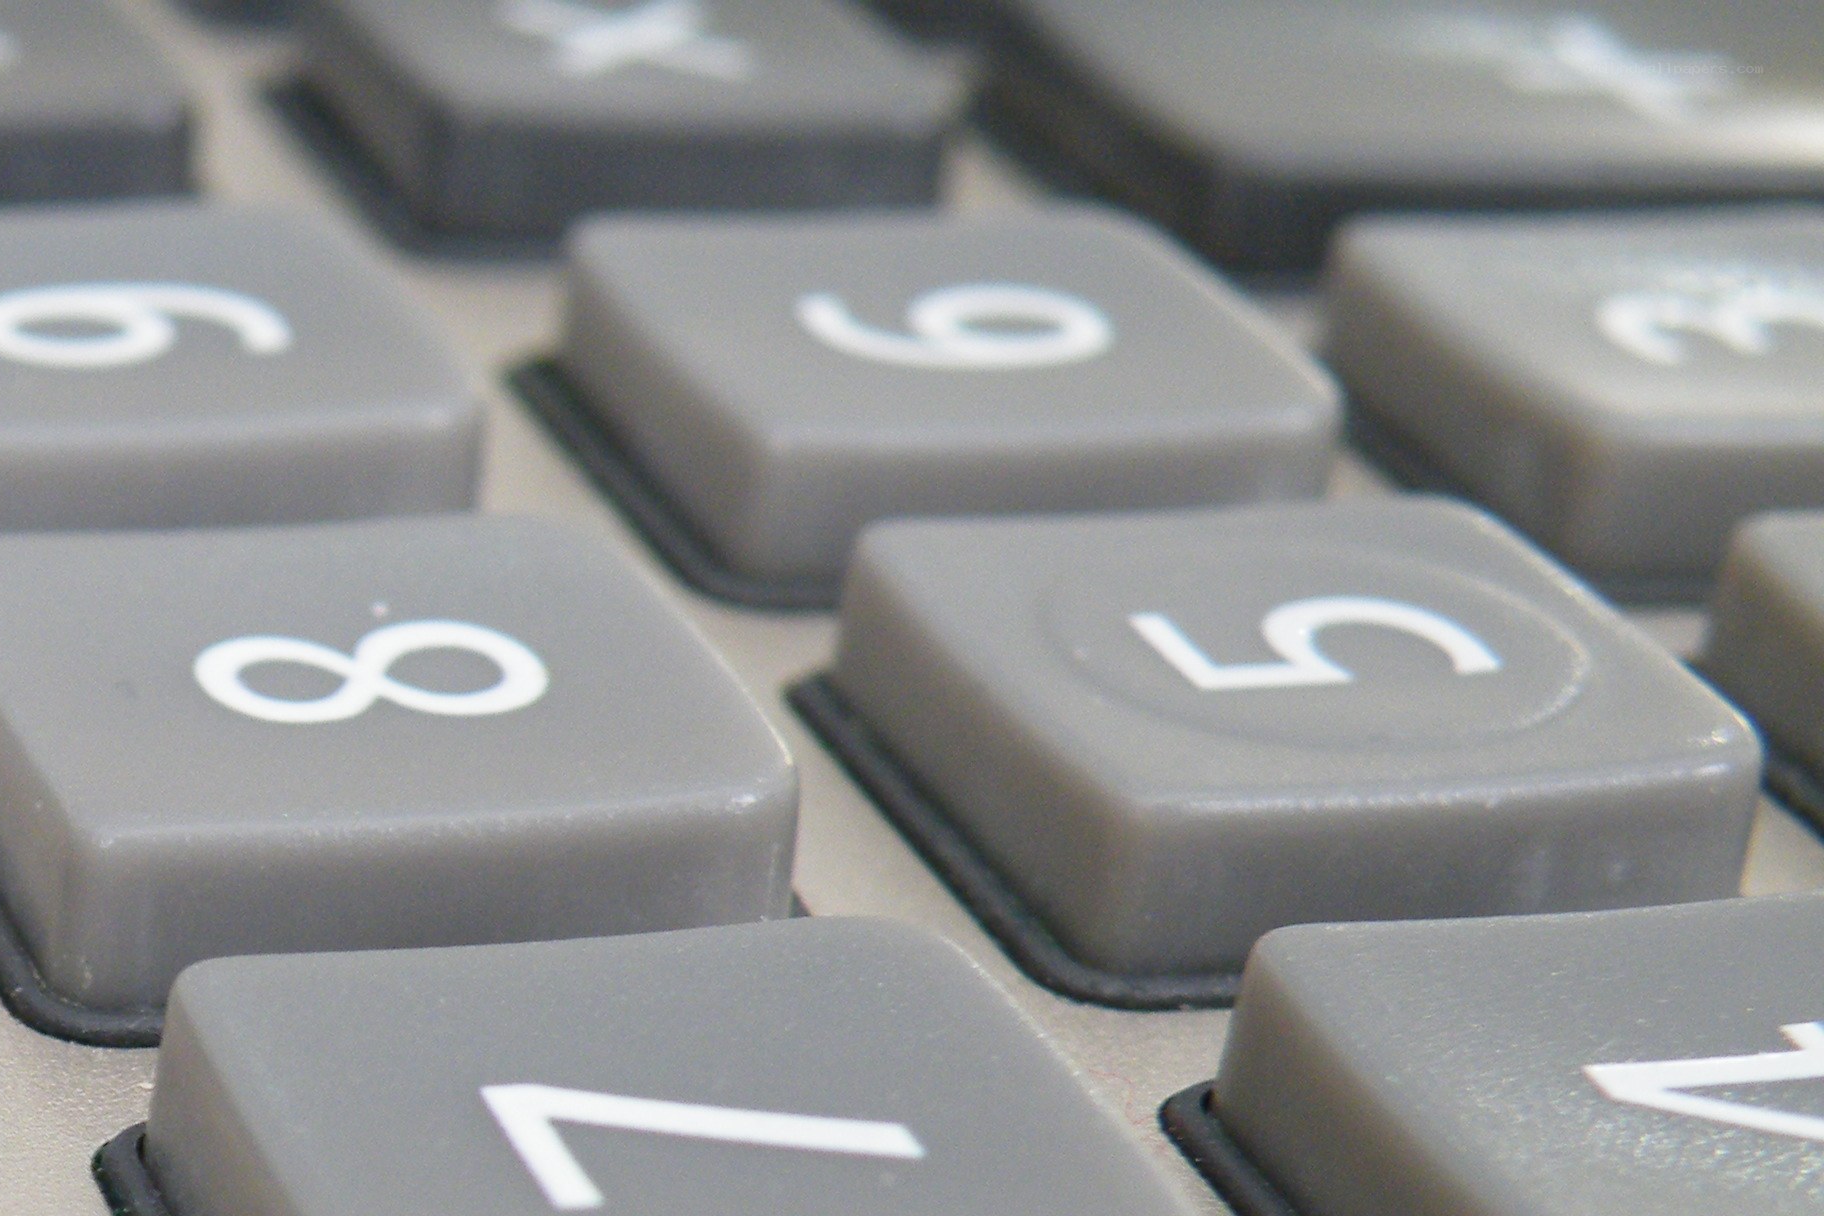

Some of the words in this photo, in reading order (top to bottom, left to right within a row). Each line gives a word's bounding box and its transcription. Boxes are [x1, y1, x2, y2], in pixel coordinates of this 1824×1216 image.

[796, 282, 1113, 369] 6
[193, 619, 548, 723] 8
[1127, 596, 1504, 690] 5
[479, 1083, 928, 1209] 7
